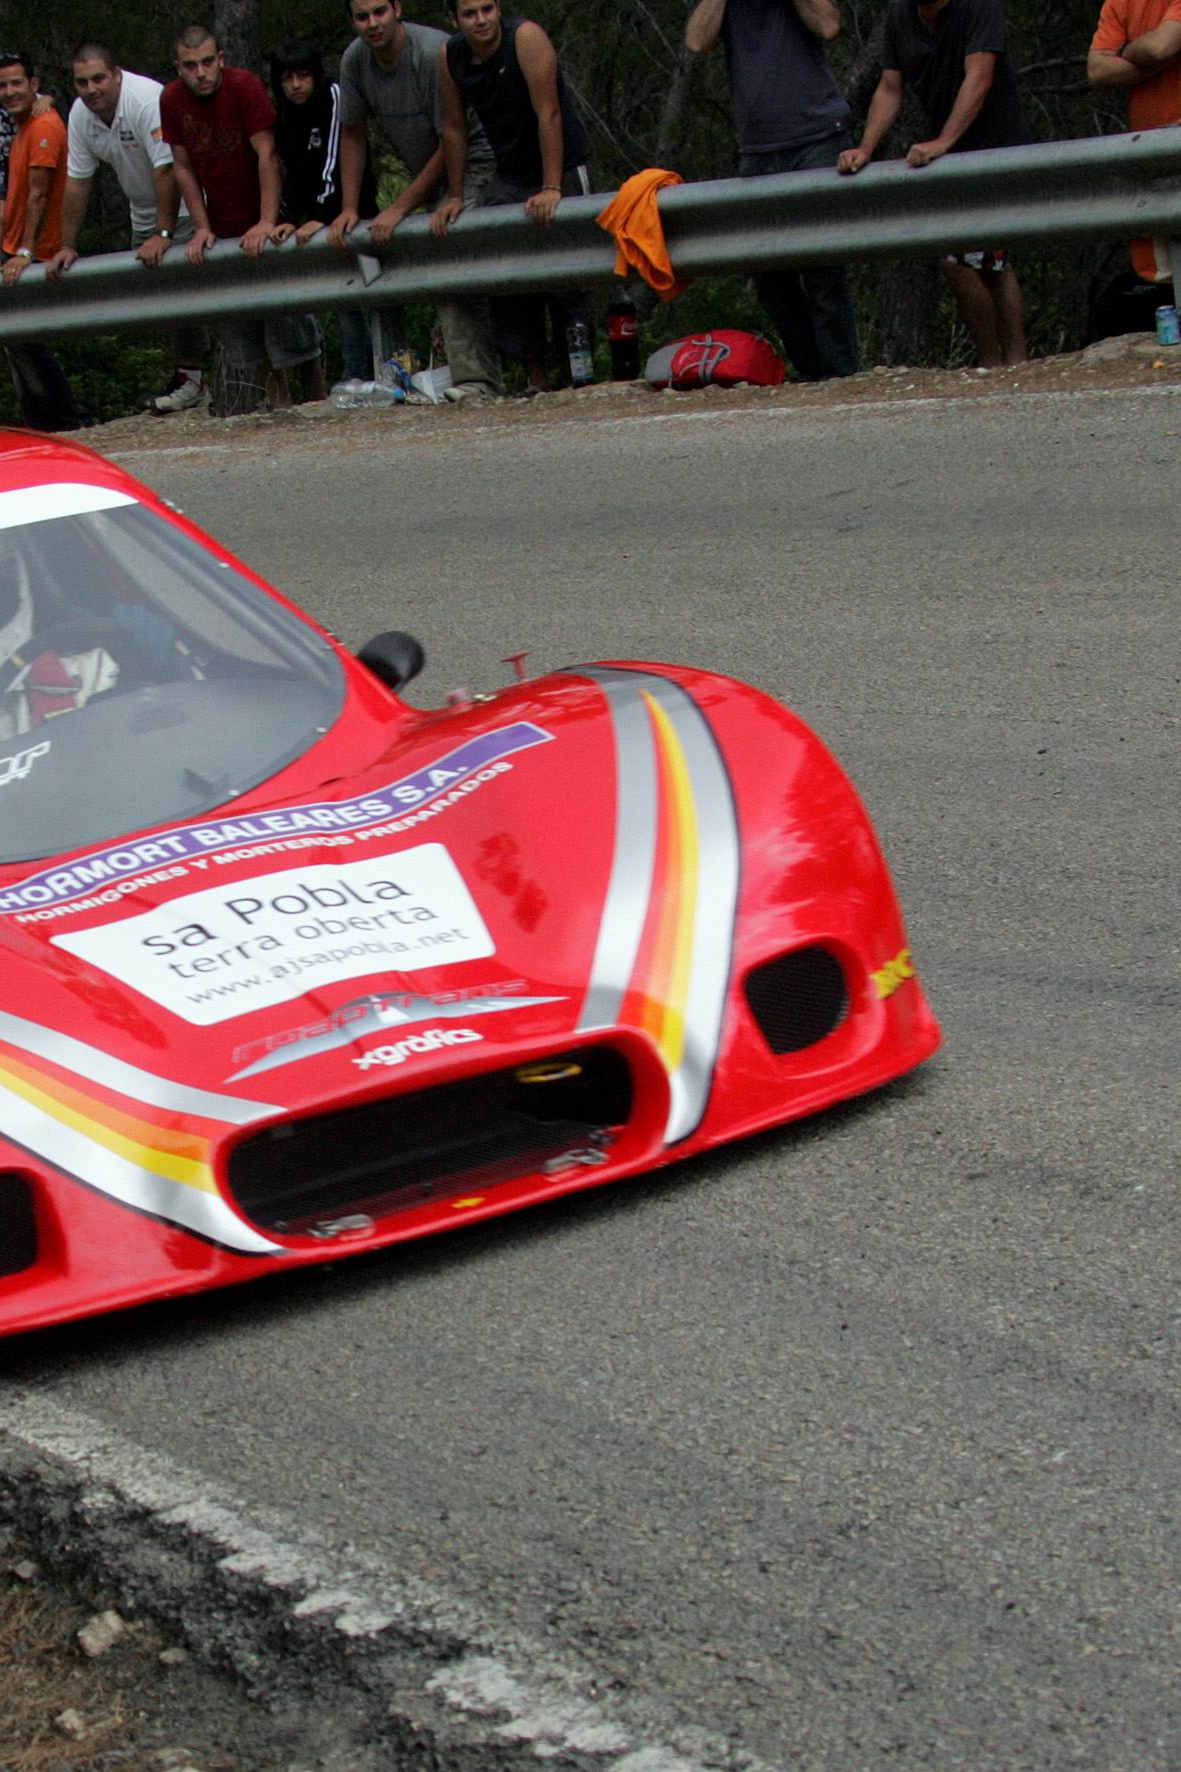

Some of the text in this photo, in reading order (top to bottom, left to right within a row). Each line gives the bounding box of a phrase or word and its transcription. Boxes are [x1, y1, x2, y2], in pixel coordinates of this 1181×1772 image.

[15, 761, 514, 924] HORMIGONES Y MORTEROS PREPARADOS
[190, 799, 393, 847] BALEARES
[392, 766, 469, 805] S.A.
[142, 879, 413, 956] sa Pobla
[167, 905, 439, 979] terra oberta
[186, 926, 470, 1005] www.ajsapobla.net
